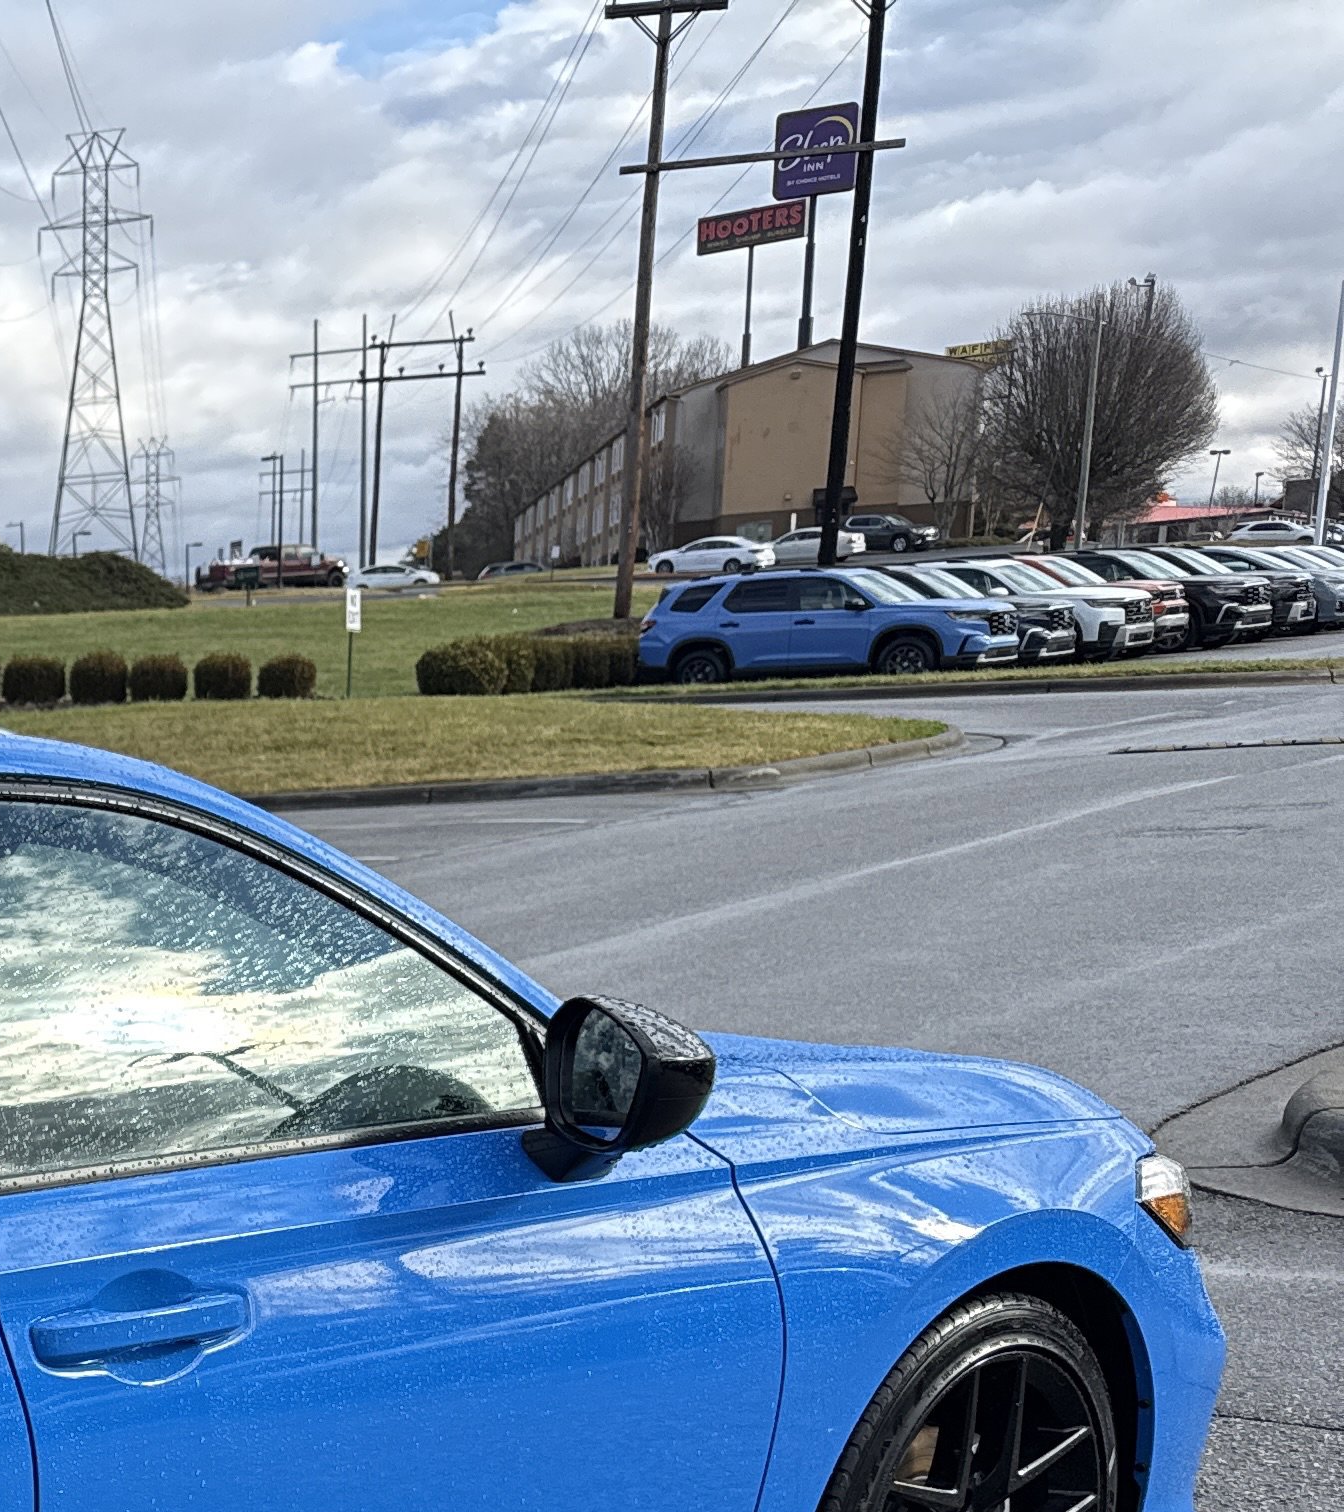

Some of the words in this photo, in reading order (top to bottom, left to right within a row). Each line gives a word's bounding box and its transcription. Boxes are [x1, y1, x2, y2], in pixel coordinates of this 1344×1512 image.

[778, 130, 845, 171] Slp
[803, 161, 824, 172] INN
[700, 204, 803, 242] HOOTERS
